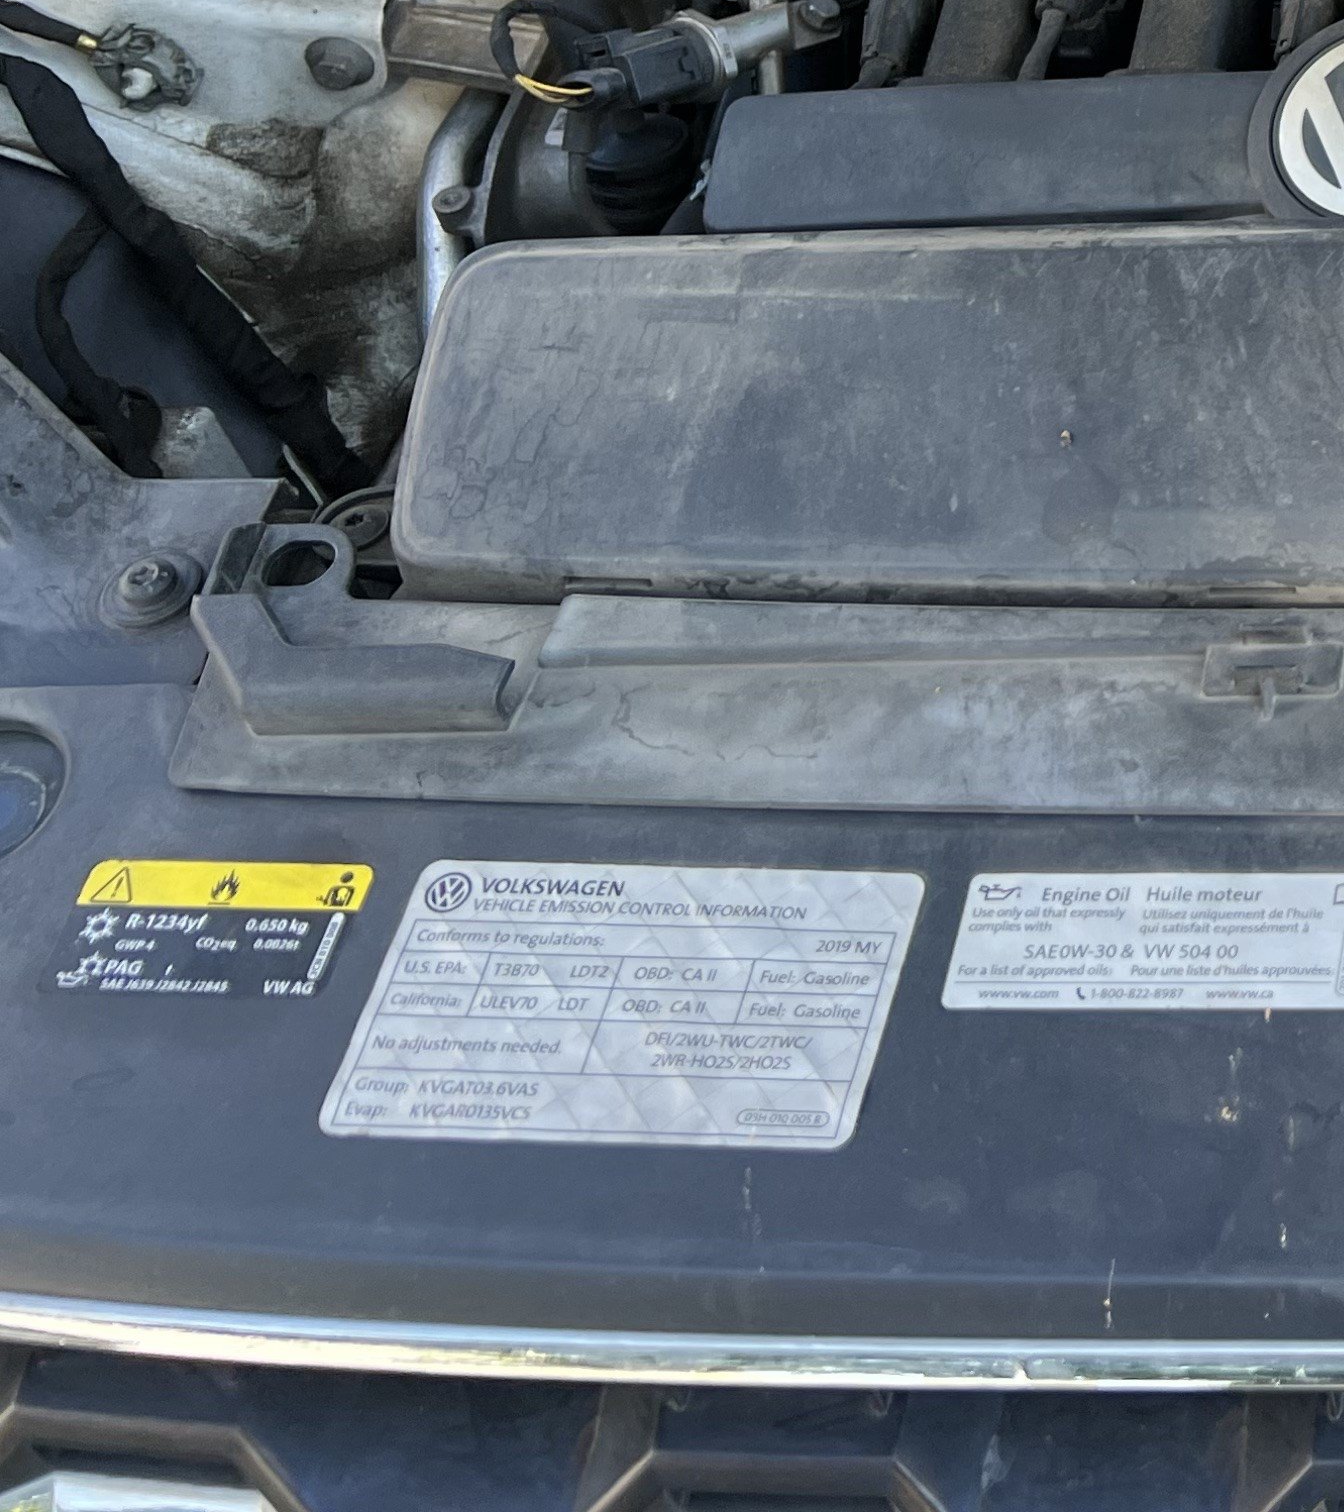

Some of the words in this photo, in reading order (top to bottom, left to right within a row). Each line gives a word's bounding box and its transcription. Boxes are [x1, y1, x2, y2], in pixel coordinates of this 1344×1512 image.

[482, 877, 625, 897] VOLKSWAGEN
[1042, 887, 1101, 905] Engine
[1105, 886, 1131, 901] Oil
[1147, 886, 1193, 902] Huile
[1197, 889, 1263, 902] moteur
[473, 898, 535, 913] VEHICLE
[538, 900, 614, 915] EMISSION
[618, 901, 690, 917] CONTROL
[696, 903, 807, 920] INFORMATION
[971, 908, 994, 918] Use
[997, 906, 1023, 921] only
[1025, 906, 1040, 918] oil
[1042, 906, 1067, 918] that
[1070, 907, 1127, 921] expressly
[1142, 908, 1188, 920] Utilisez
[1190, 908, 1265, 923] uniquement
[1268, 908, 1284, 920] de
[125, 912, 208, 934] R-1234yf
[245, 917, 288, 933] 0.650
[289, 917, 309, 936] kg
[968, 922, 1022, 934] complies
[1024, 921, 1053, 932] with
[1139, 923, 1159, 937] qui
[1161, 921, 1211, 934] satisfait
[417, 928, 490, 943] Conforms
[493, 929, 509, 943] to
[513, 931, 605, 949] regulations:
[815, 939, 852, 954] 2019
[854, 941, 882, 955] MY
[1023, 944, 1118, 960] SAE0W-30
[1120, 944, 1135, 960] &
[1144, 944, 1175, 959] VW
[1178, 944, 1211, 959] 504
[1215, 944, 1239, 959] 00
[104, 959, 144, 976] PAG
[403, 960, 431, 974] U.S.
[434, 961, 467, 975] EPA:
[493, 962, 540, 977] T3B70
[569, 964, 609, 979] LDT2
[634, 966, 673, 981] OBD:
[681, 968, 704, 982] CA
[760, 970, 796, 984] Fuel:
[803, 971, 870, 987] Gasoline
[957, 964, 978, 976] For
[991, 964, 1009, 976] list
[1011, 964, 1026, 976] of
[1027, 964, 1085, 979] approved
[1130, 964, 1159, 976] Pour
[1161, 966, 1184, 976] une
[1186, 964, 1211, 976] liste
[263, 979, 291, 995] VW
[290, 980, 316, 996] AG
[978, 988, 1060, 1000] www.vw.com
[1206, 988, 1274, 1000] www.vw.ca
[390, 991, 462, 1009] California:
[480, 995, 538, 1010] ULEV70
[557, 997, 589, 1011] LDT
[622, 999, 662, 1014] OBD:
[670, 1000, 691, 1015] CA
[750, 1002, 786, 1017] Fuel:
[794, 1004, 861, 1020] Gasoline
[371, 1035, 397, 1050] No
[398, 1036, 496, 1055] adjustments
[500, 1039, 562, 1054] needed.
[354, 1076, 410, 1096] Group:
[344, 1101, 388, 1119] Evap:
